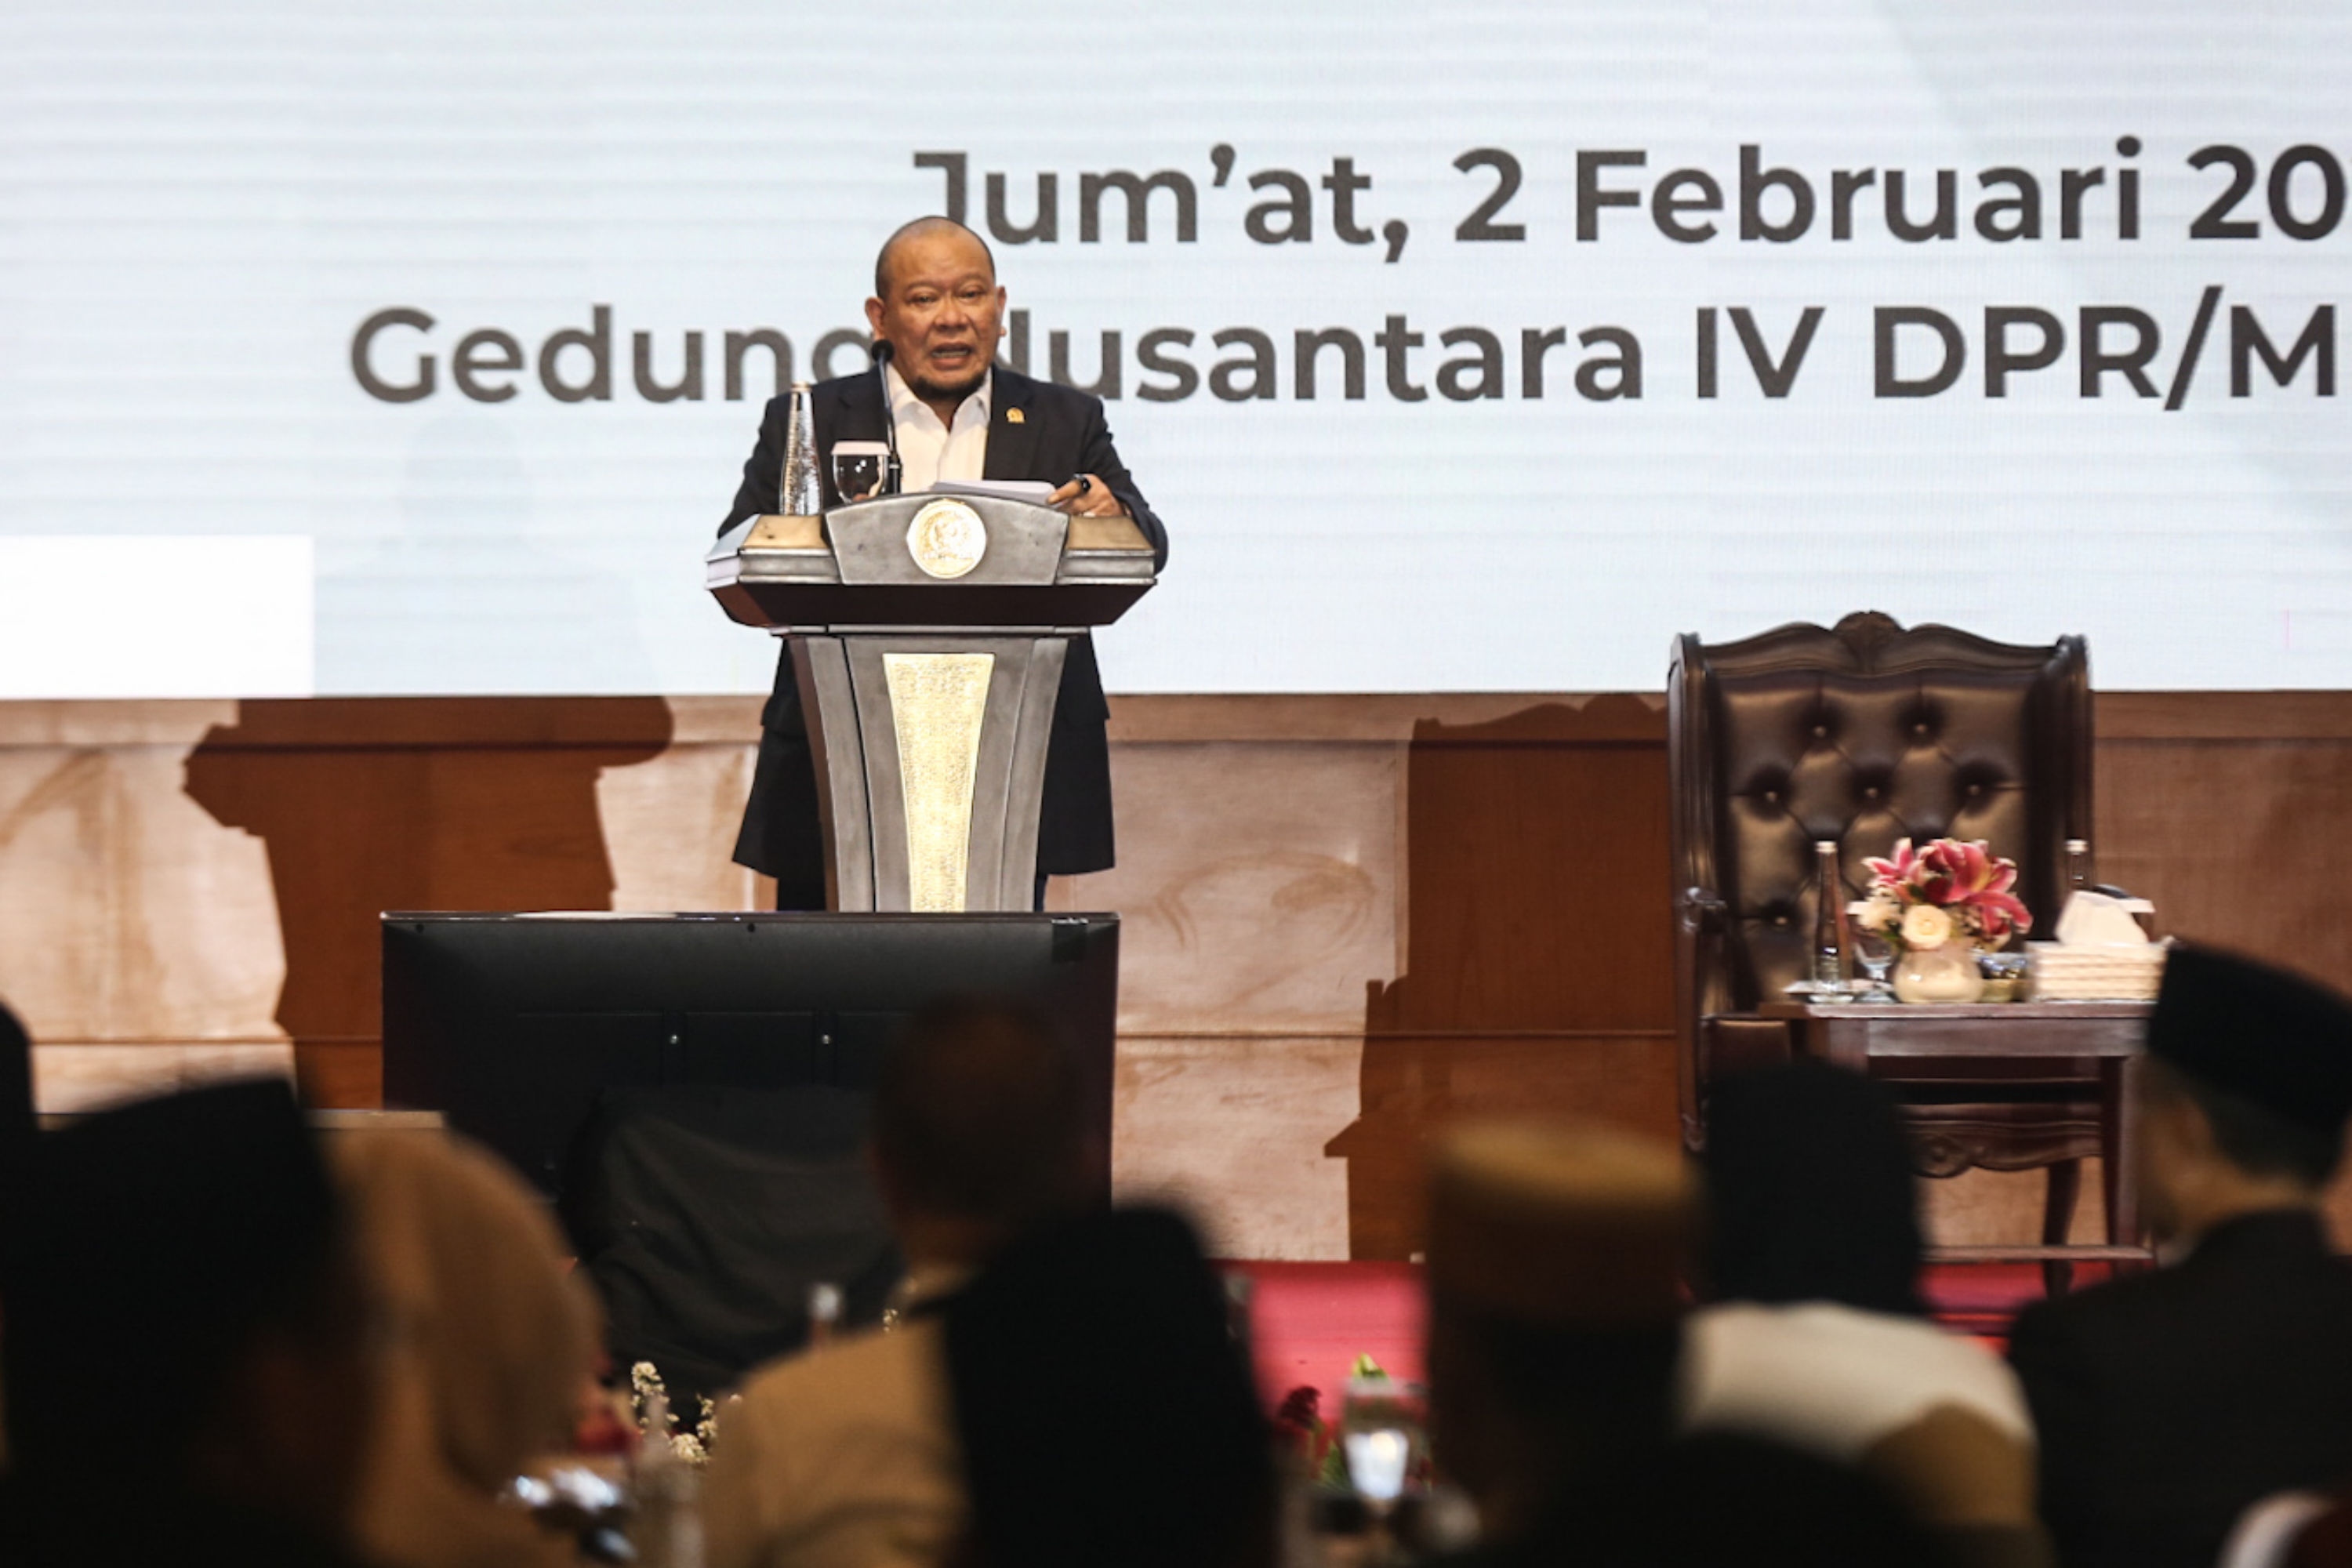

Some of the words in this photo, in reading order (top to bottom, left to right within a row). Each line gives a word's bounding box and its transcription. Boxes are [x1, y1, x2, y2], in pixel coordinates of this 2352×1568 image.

[1453, 148, 1526, 241] 2
[1576, 135, 2142, 244] Februari
[1697, 307, 1825, 399] IV
